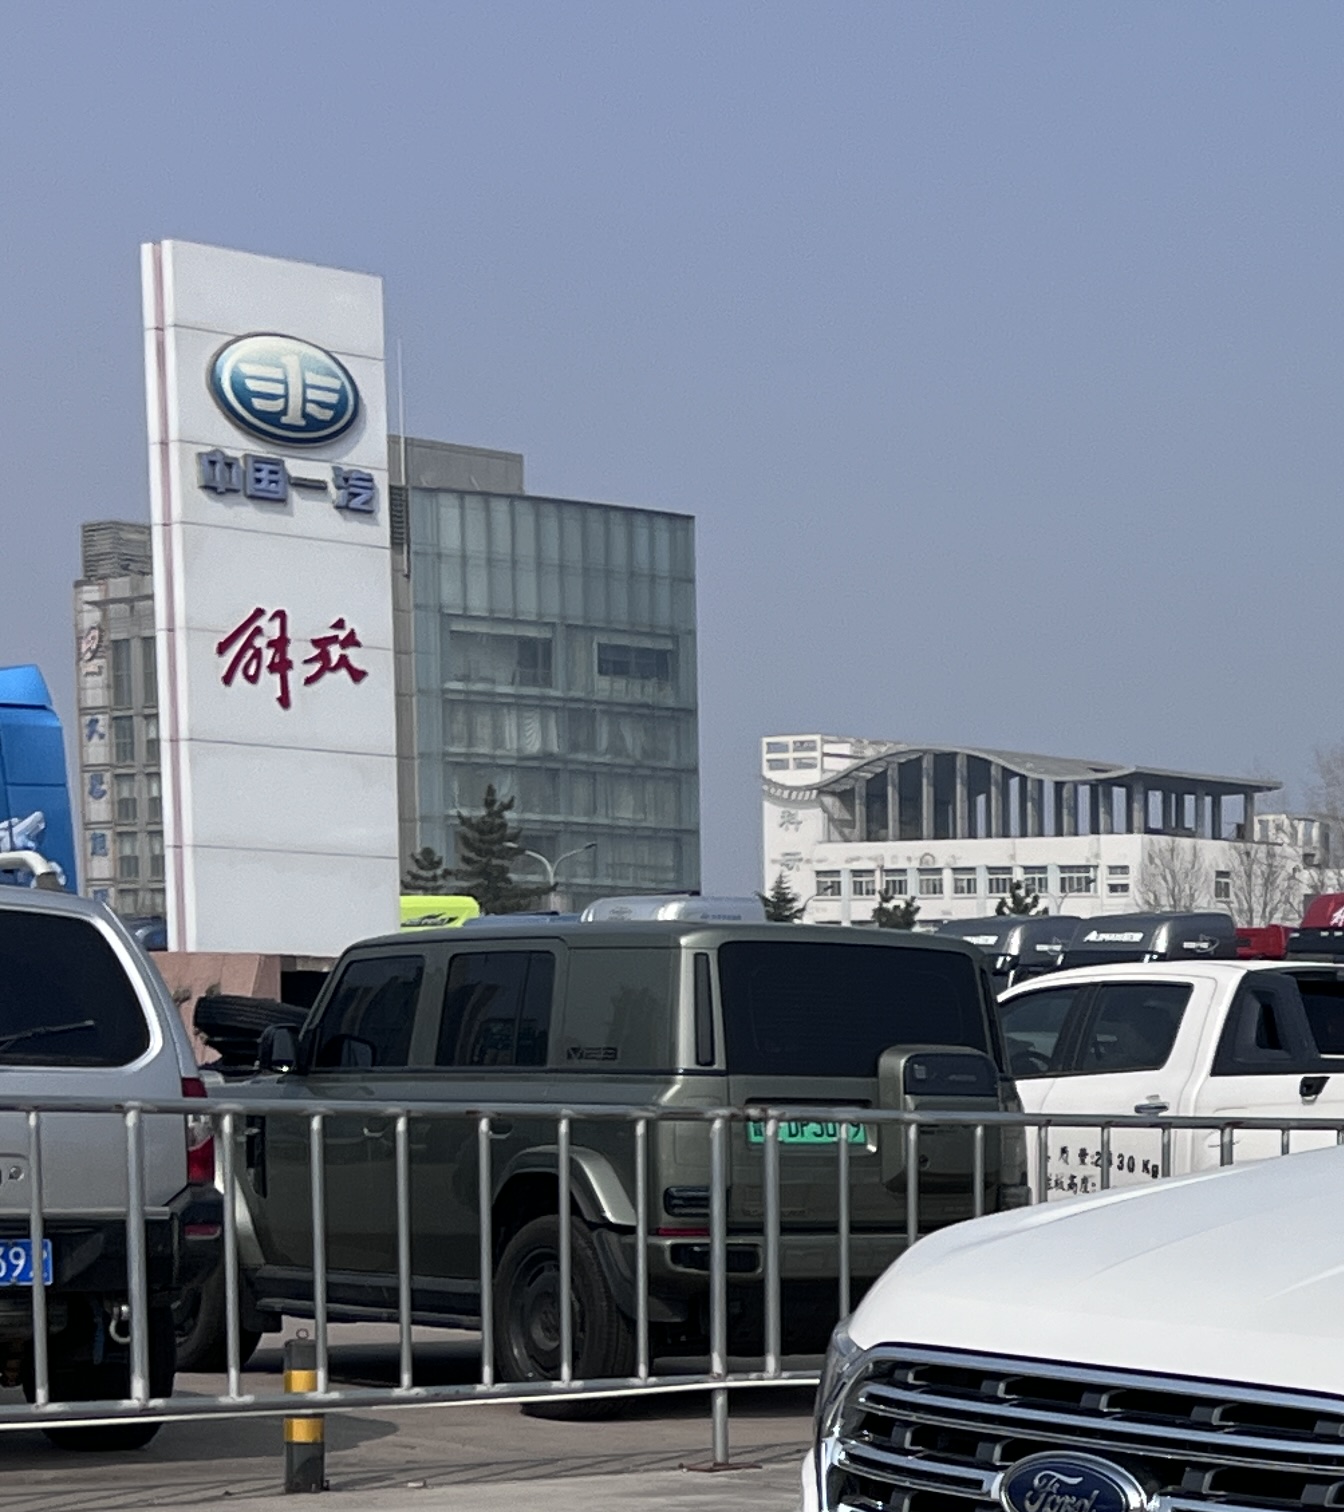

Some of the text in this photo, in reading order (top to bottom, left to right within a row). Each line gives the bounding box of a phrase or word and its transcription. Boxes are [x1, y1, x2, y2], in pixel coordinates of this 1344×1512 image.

[198, 449, 375, 514] 中国一汽
[217, 607, 369, 710] 解放
